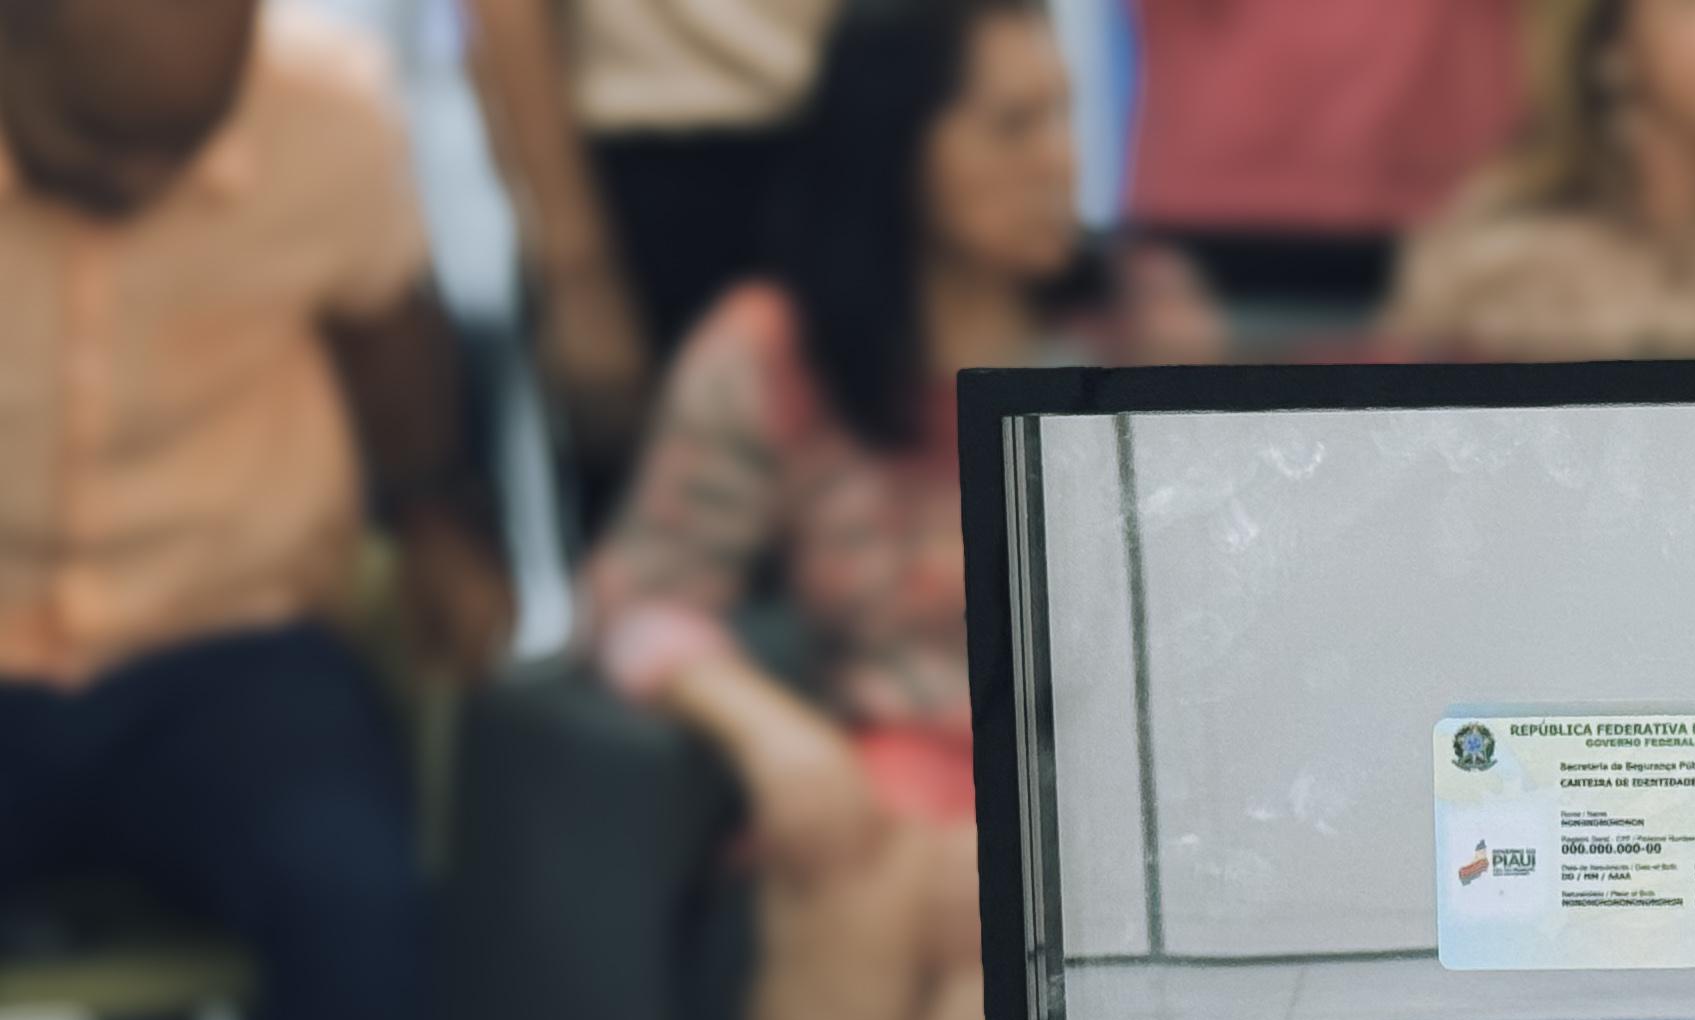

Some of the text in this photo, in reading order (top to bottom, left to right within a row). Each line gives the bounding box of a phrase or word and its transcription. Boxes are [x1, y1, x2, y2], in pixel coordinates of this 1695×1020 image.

[1510, 719, 1592, 736] REPÚBLICA
[1597, 722, 1687, 736] FEDERATIVA
[1586, 737, 1695, 748] GOVERNO FEDERAL
[1560, 778, 1612, 788] CARTEIRA
[1561, 843, 1662, 855] 000.000.000-00
